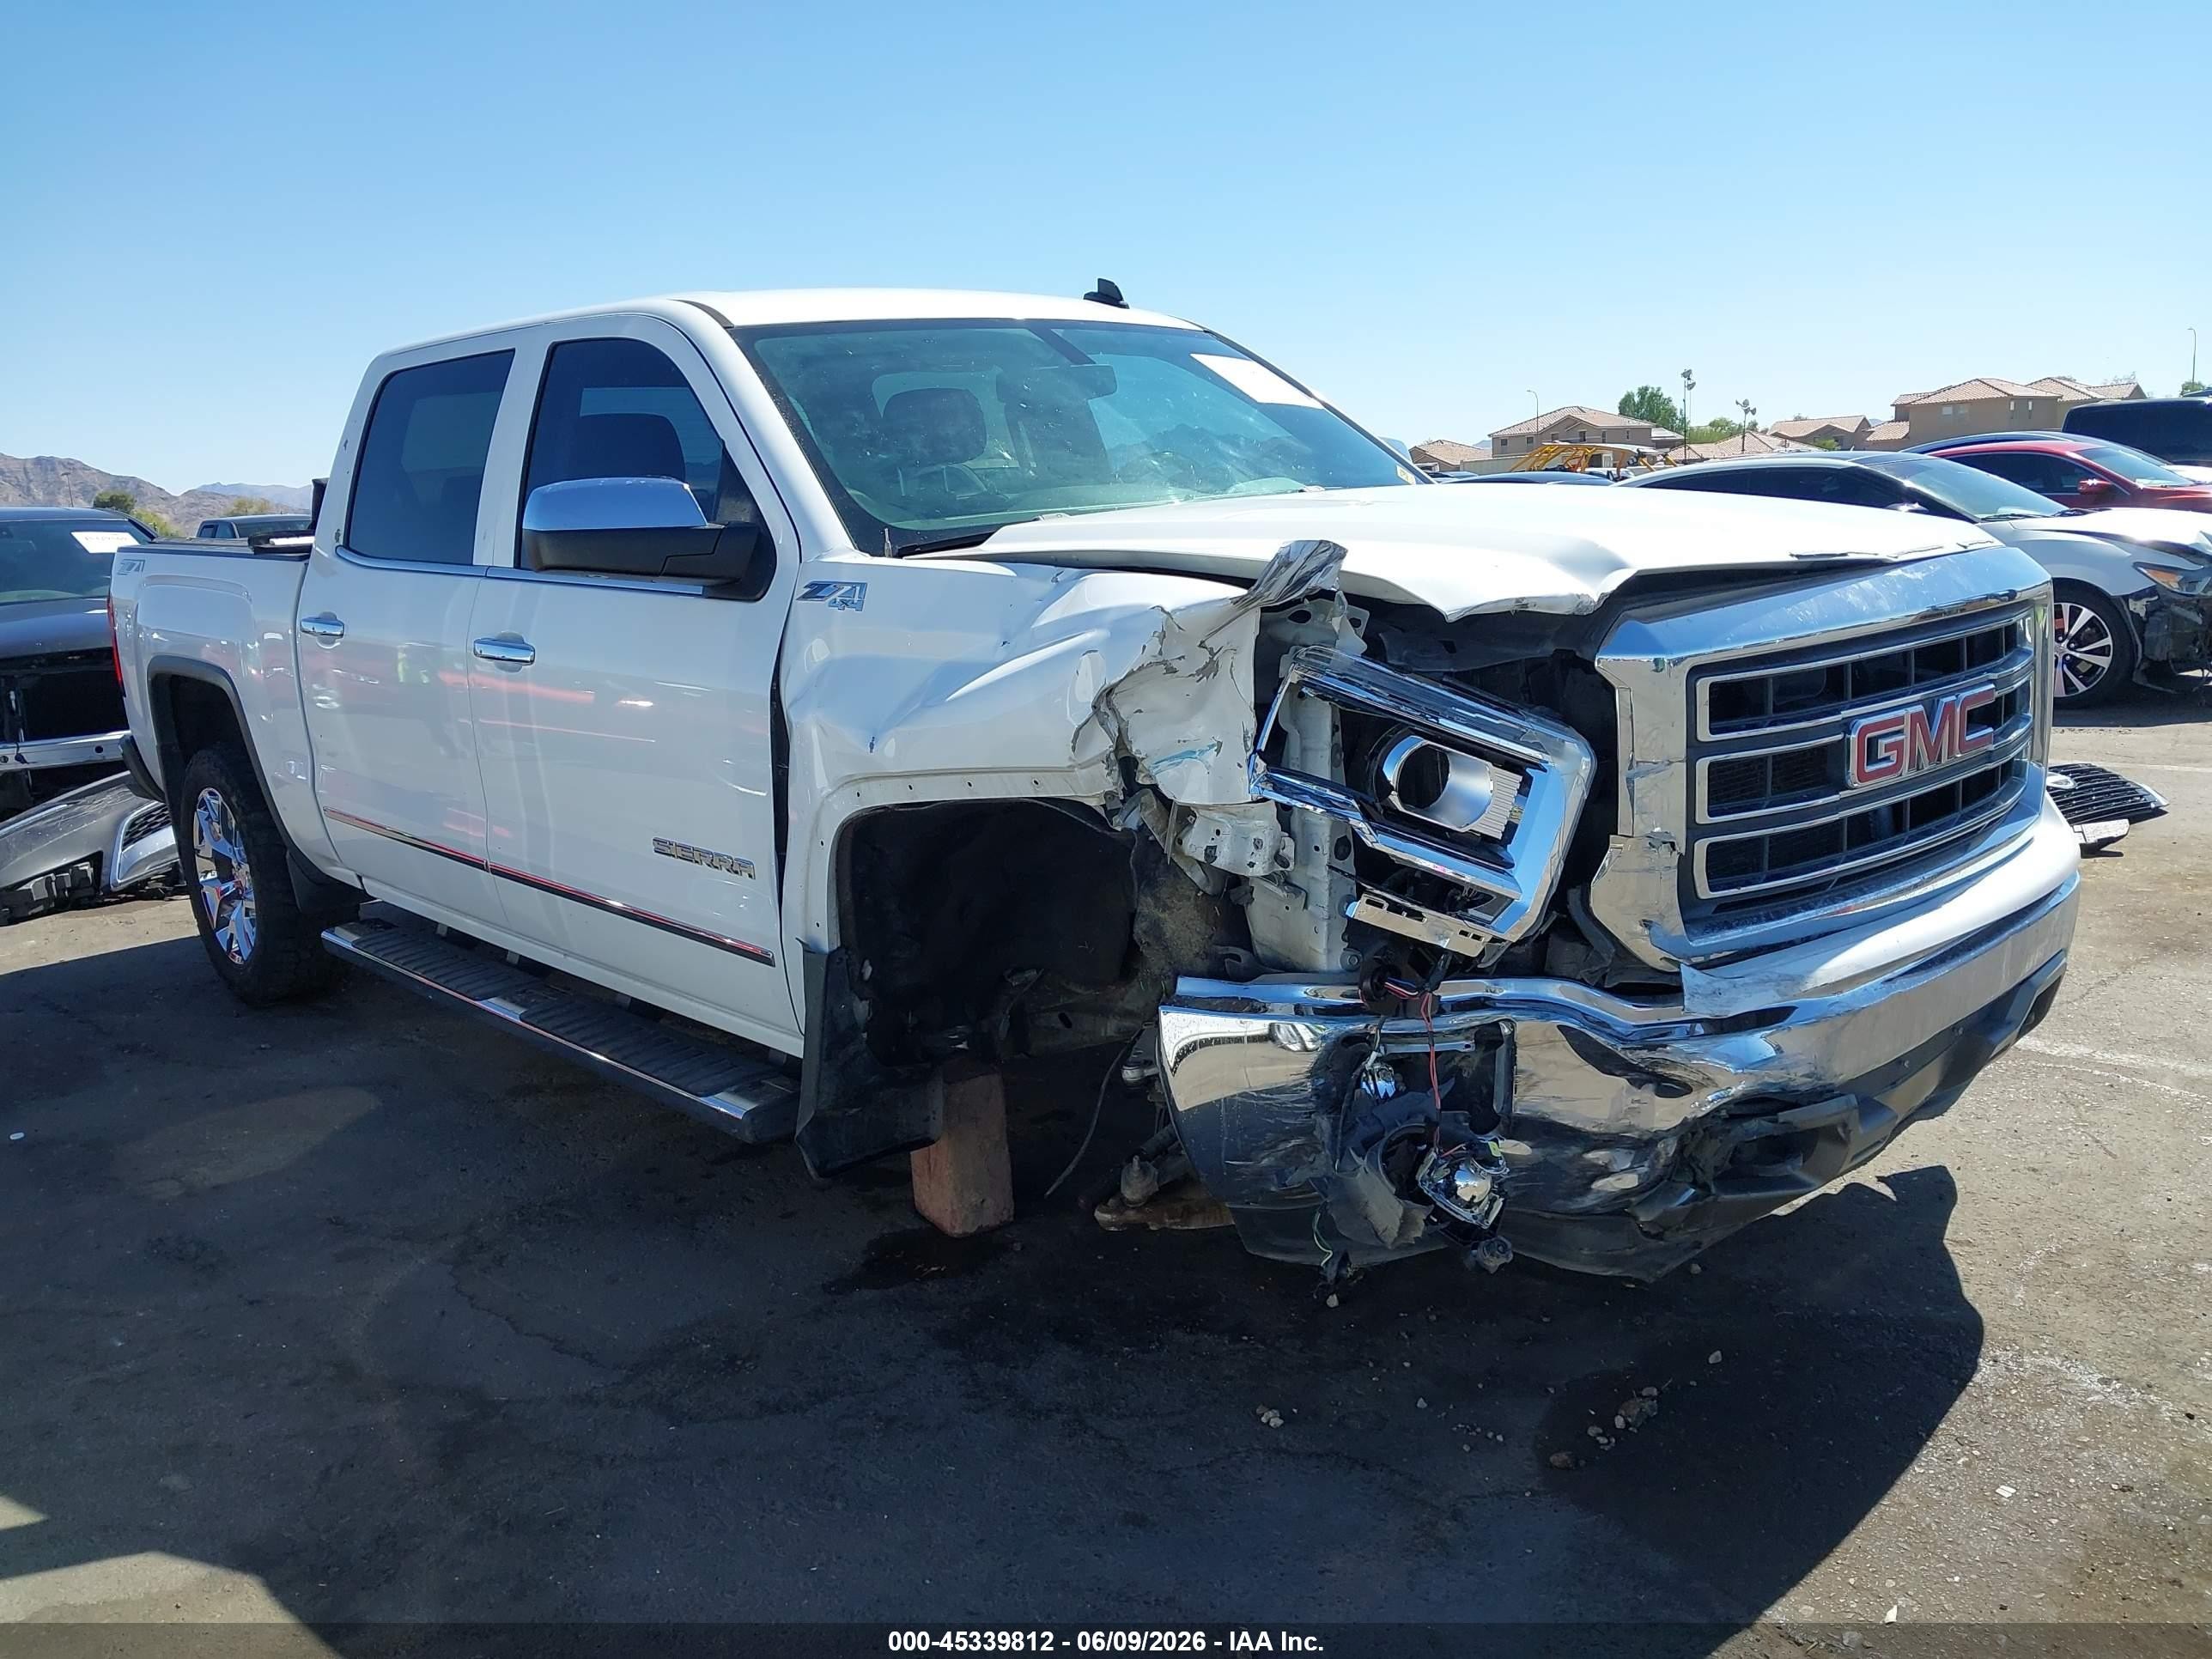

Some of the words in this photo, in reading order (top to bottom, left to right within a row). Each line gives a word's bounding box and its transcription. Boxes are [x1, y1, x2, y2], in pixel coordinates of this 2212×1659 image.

[795, 580, 868, 604] Z71
[1849, 684, 1996, 787] GMC
[652, 836, 757, 880] SIERRA
